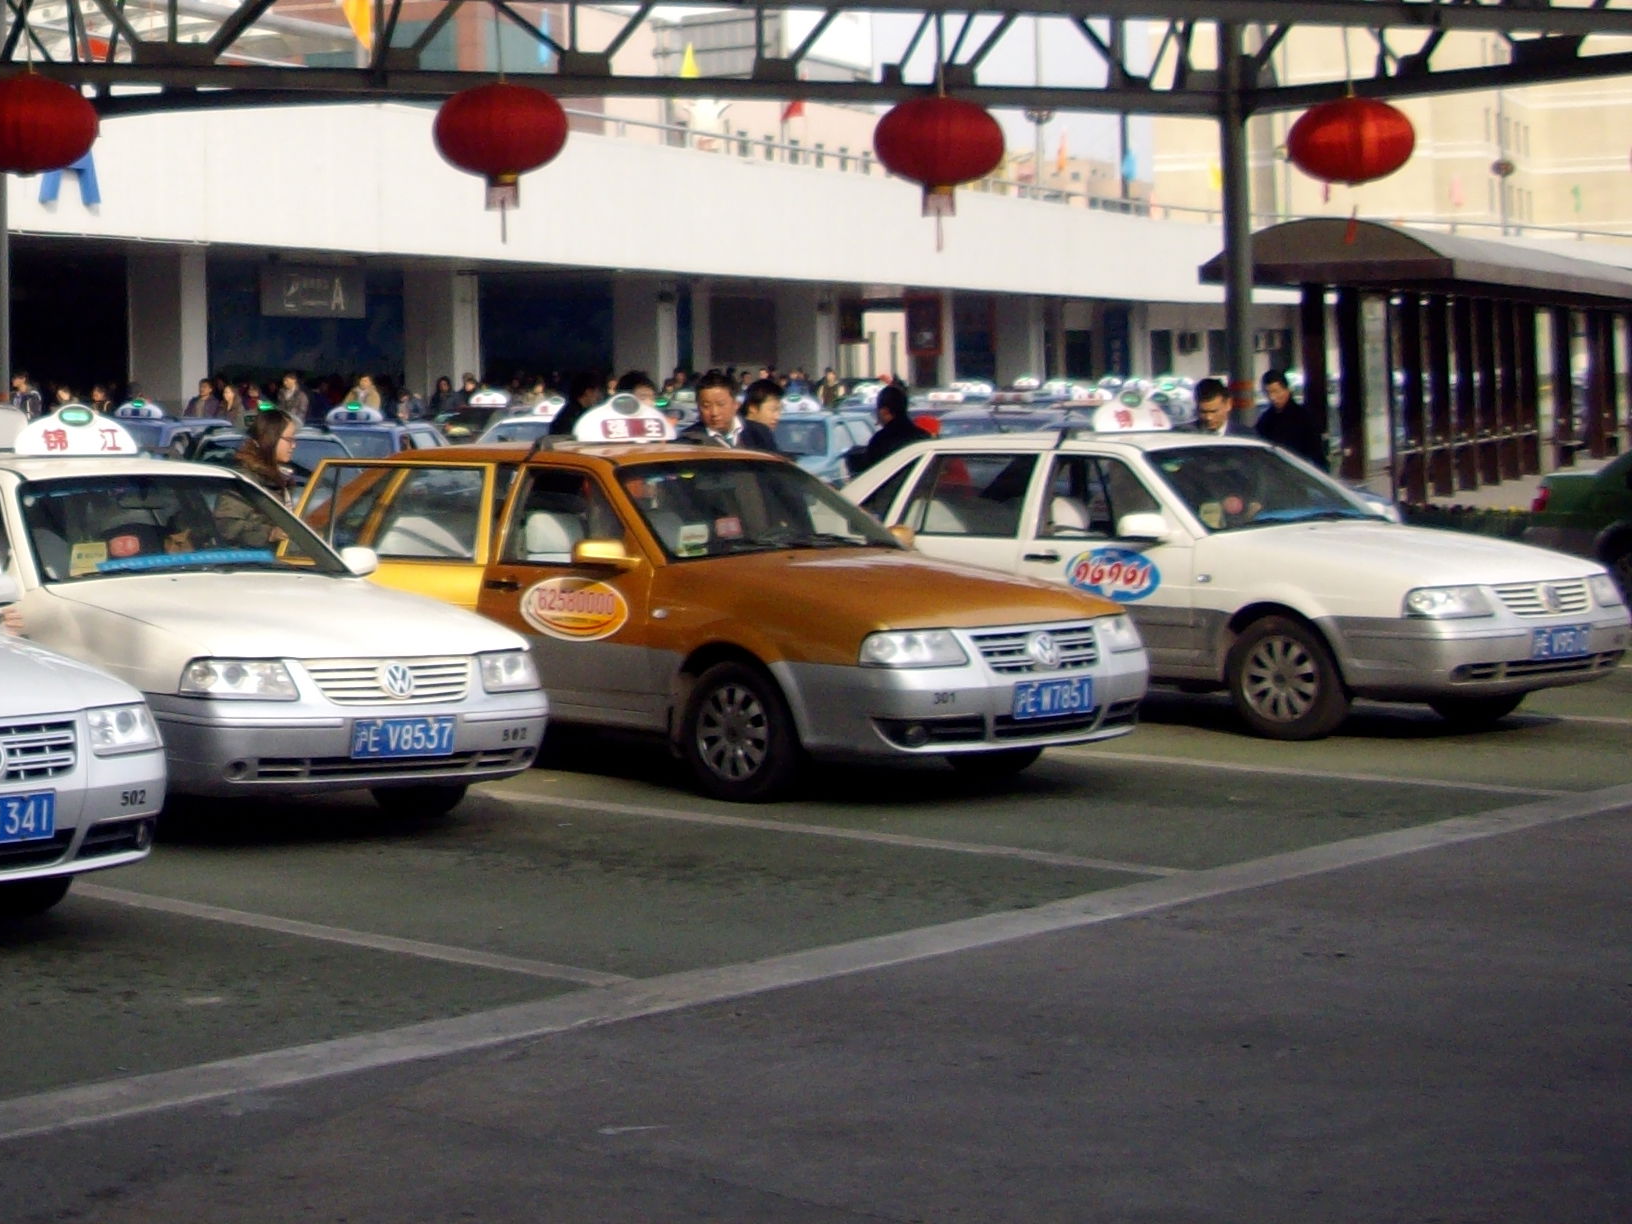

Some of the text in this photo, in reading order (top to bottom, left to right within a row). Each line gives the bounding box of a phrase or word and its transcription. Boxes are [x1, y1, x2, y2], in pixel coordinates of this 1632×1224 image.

[42, 428, 122, 452] 锦江
[933, 692, 956, 705] 301
[120, 789, 147, 807] 502
